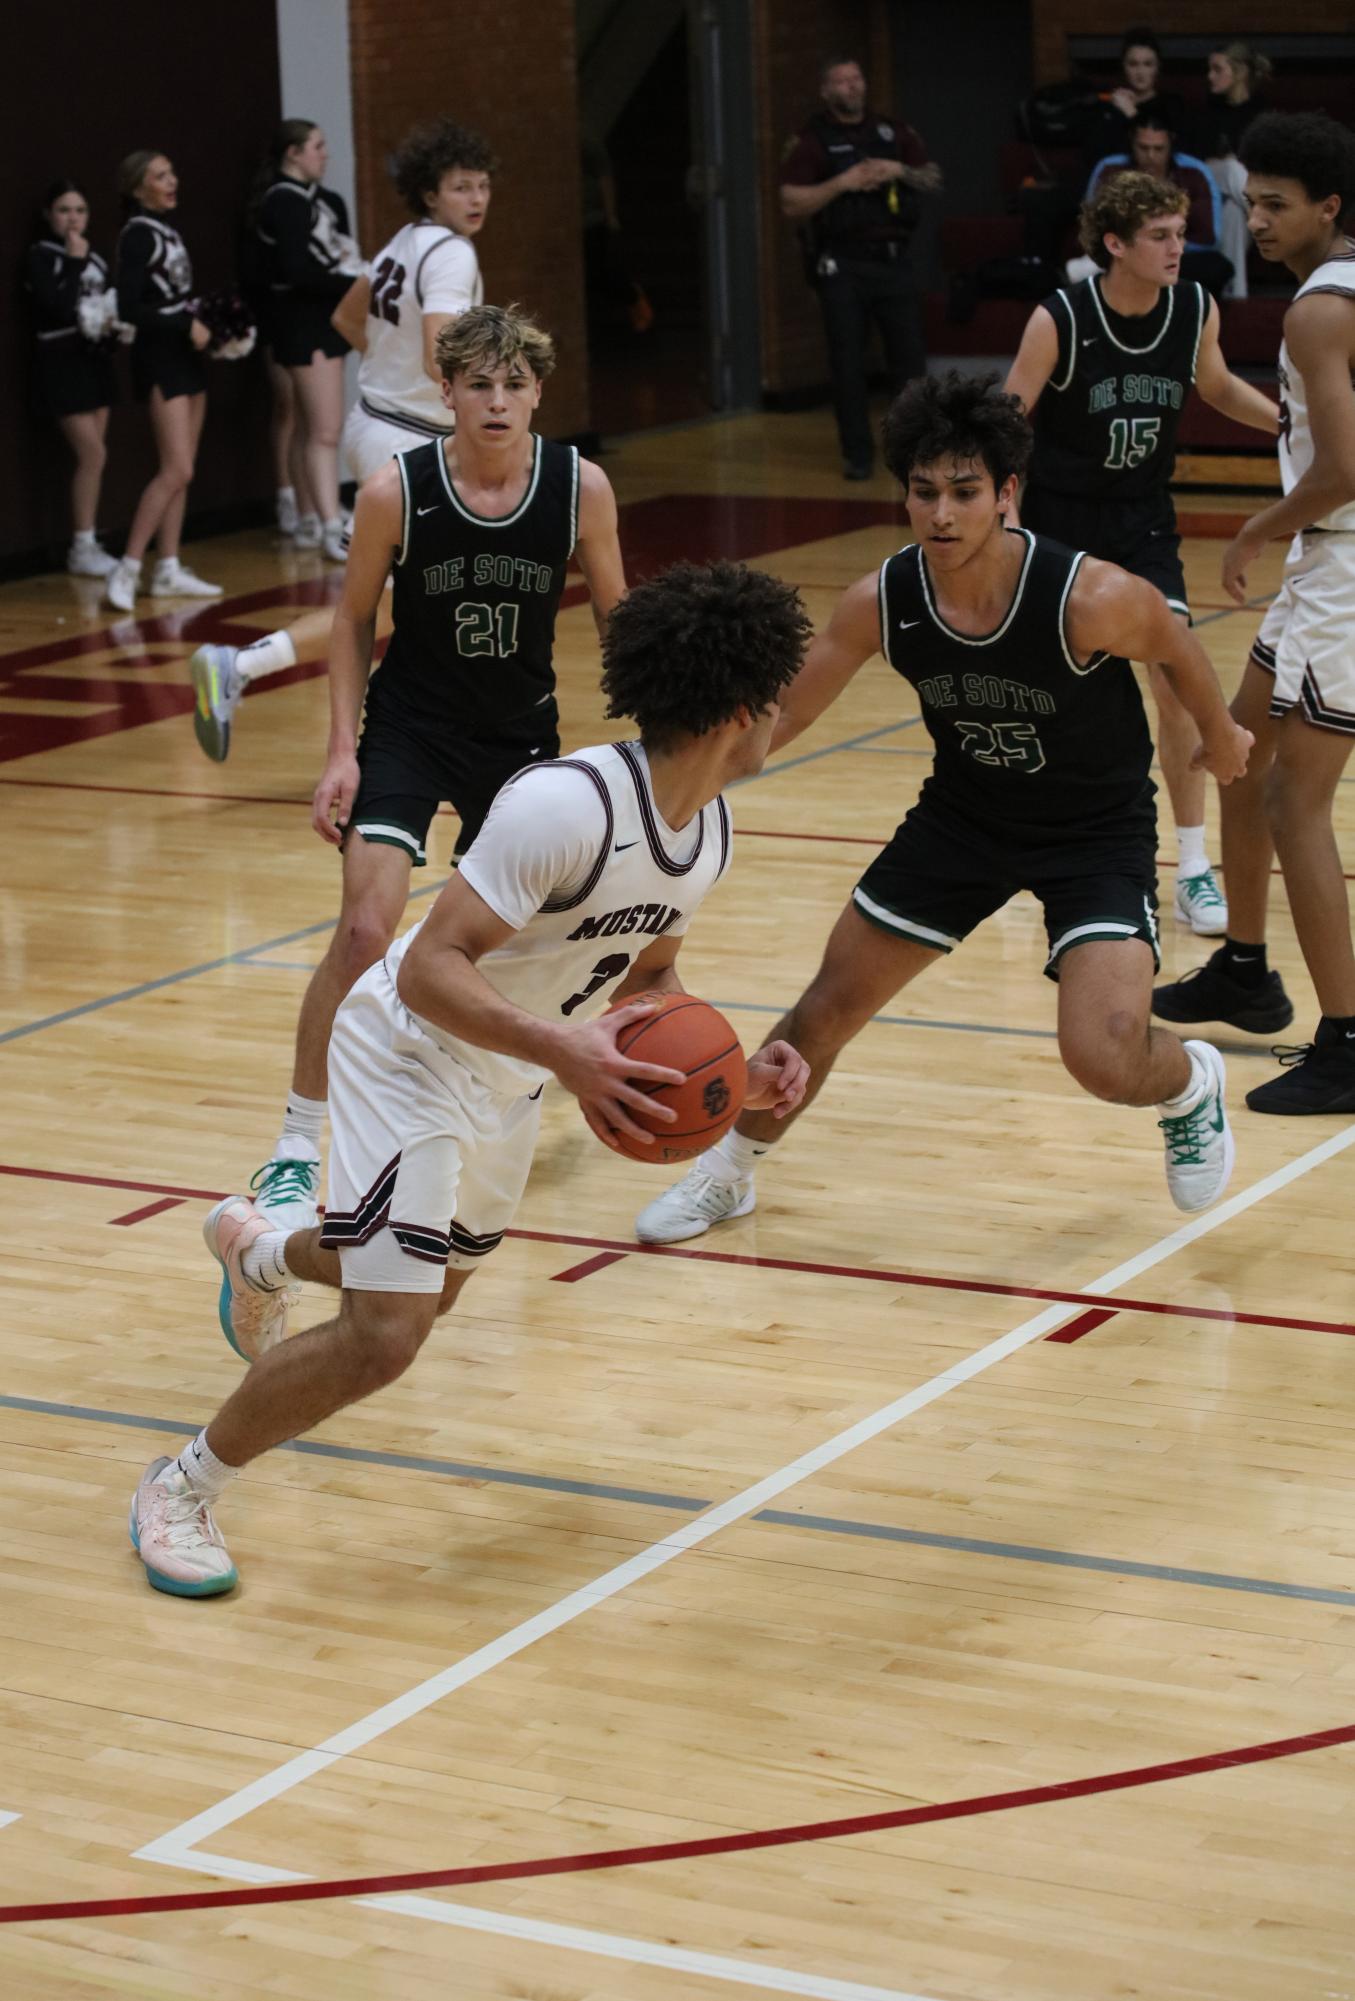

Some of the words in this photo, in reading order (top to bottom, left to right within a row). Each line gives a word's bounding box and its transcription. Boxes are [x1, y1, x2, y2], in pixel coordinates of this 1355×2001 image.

[368, 256, 406, 327] 22
[1088, 377, 1117, 414] DE
[1123, 373, 1184, 411] SOTO
[1103, 417, 1161, 469] 15
[423, 556, 465, 595] DE
[473, 554, 553, 594] SOTO
[455, 602, 519, 658] 21
[918, 674, 958, 709] DE
[962, 673, 1056, 714] SOTO
[953, 721, 1047, 774] 25
